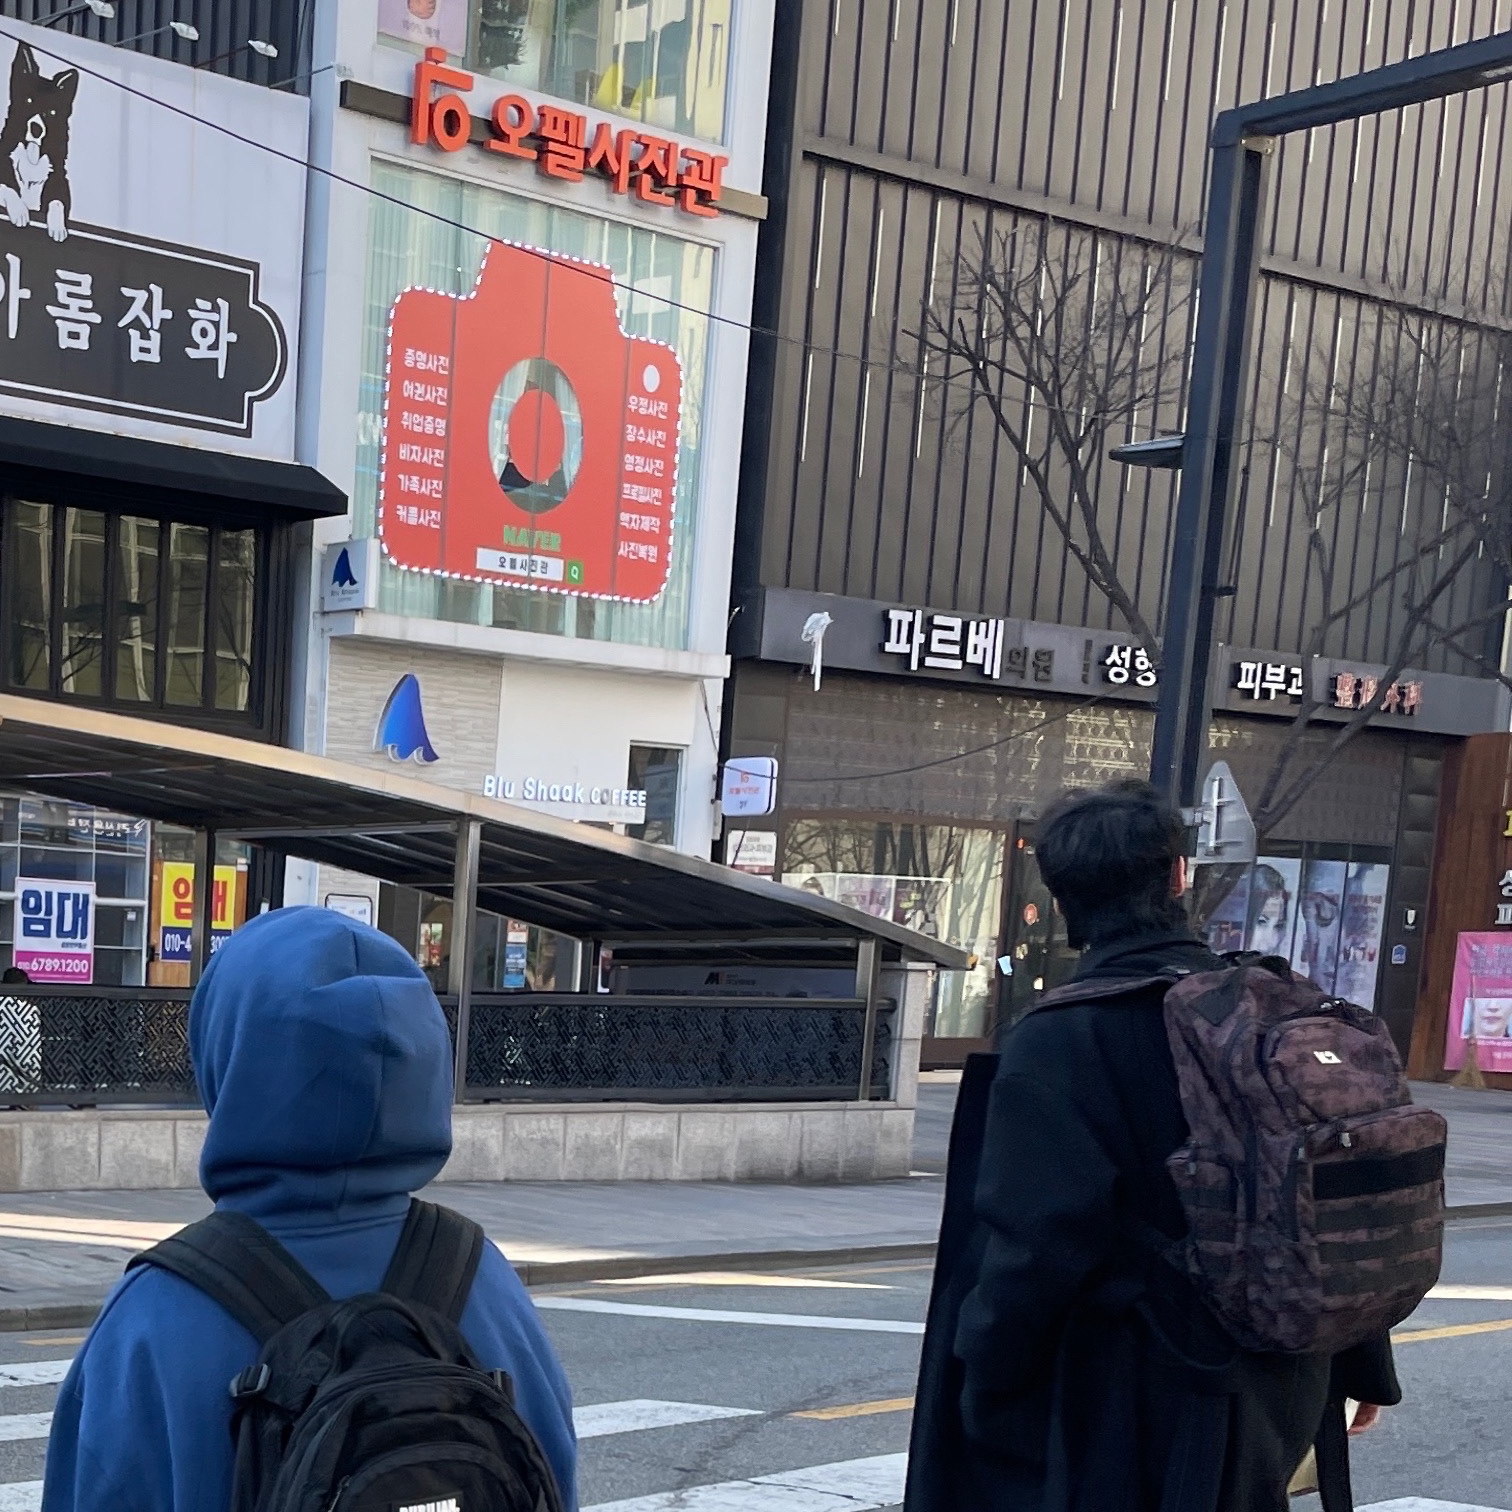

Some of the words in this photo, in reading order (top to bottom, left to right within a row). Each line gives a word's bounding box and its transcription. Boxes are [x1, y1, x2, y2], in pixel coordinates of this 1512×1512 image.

[484, 94, 729, 217] 오펠사진관
[404, 348, 449, 375] 증명사진
[402, 379, 448, 406] 여권사진
[400, 410, 447, 437] 취업증명
[399, 442, 444, 468] 비자사진
[397, 474, 443, 499] 가족사진
[884, 608, 1005, 680] 파르베
[483, 775, 515, 799] Blu
[522, 776, 585, 804] Shaak
[590, 786, 647, 808] COFFEE
[21, 889, 91, 940] 임대
